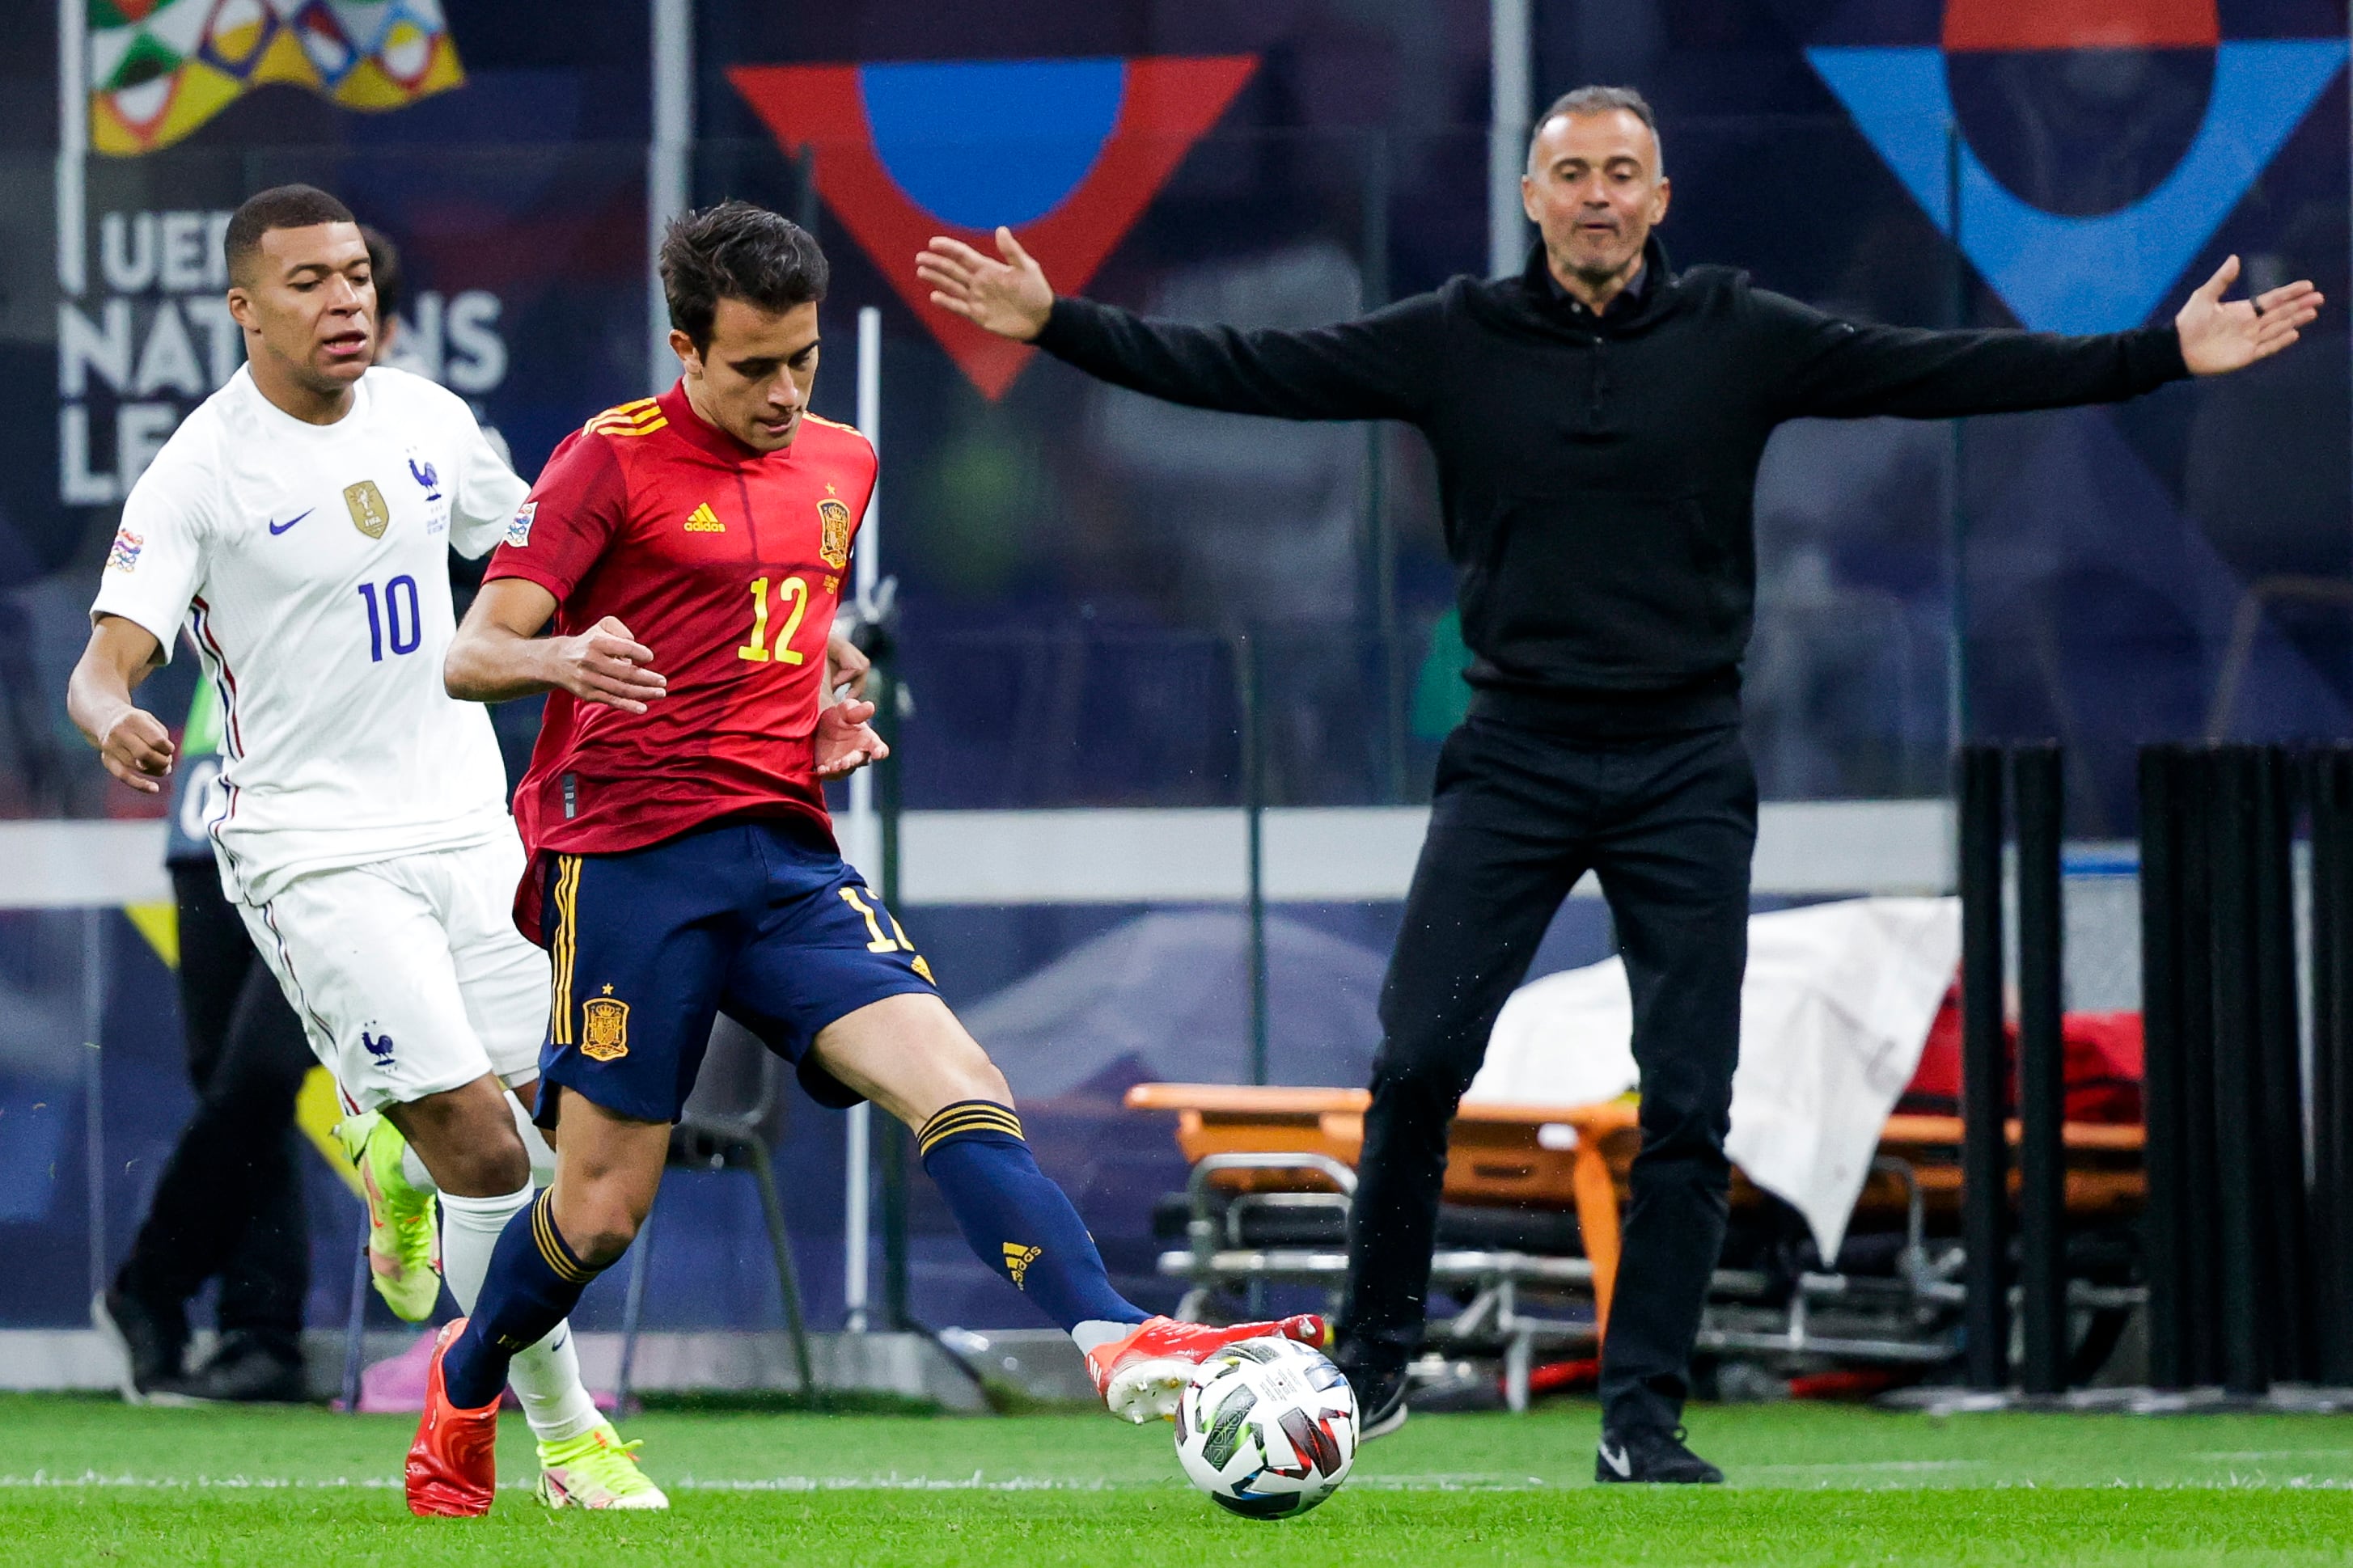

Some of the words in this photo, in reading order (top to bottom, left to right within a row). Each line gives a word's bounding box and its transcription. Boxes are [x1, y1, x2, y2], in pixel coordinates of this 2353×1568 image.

[683, 522, 726, 533] adidas
[358, 575, 421, 663] 10
[738, 576, 808, 666] 12
